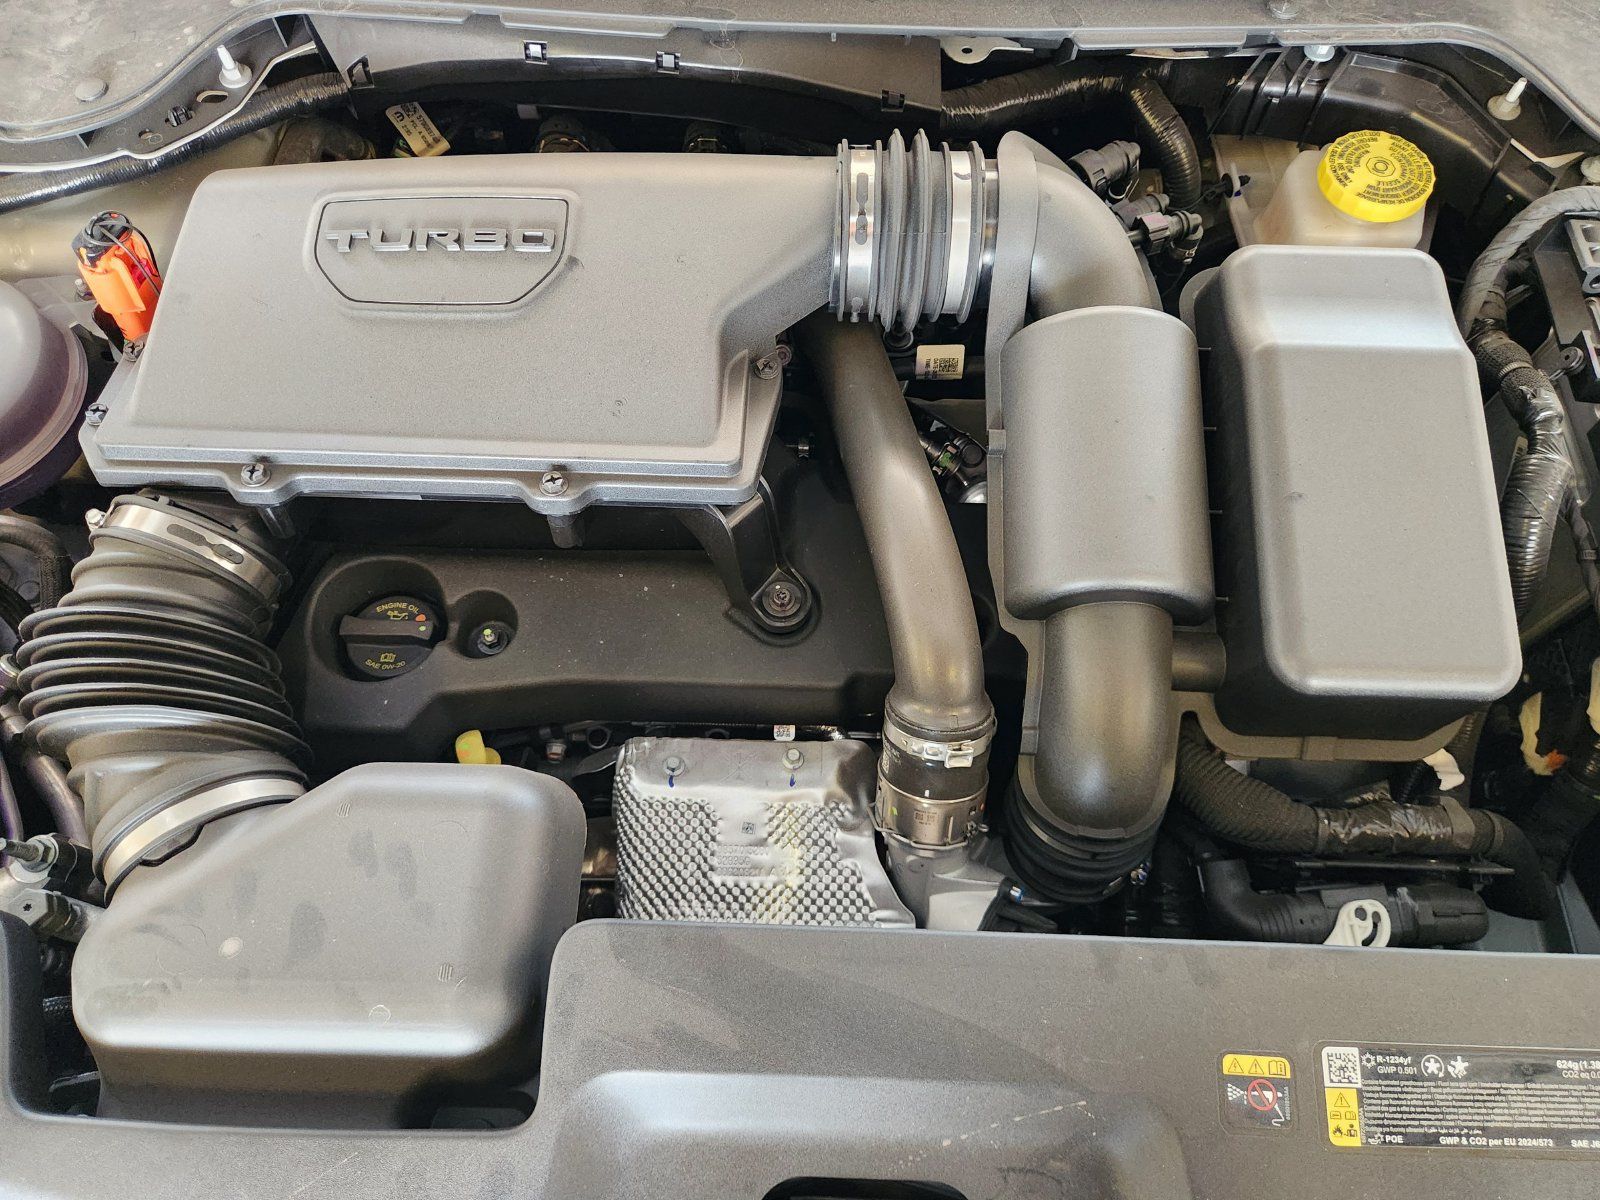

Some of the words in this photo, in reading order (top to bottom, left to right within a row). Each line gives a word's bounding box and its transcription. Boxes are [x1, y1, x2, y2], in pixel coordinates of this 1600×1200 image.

[326, 228, 556, 252] TURBO
[376, 602, 408, 613] ENGINE
[408, 604, 420, 615] OIL
[365, 659, 381, 670] SAE
[381, 660, 406, 671] 0W-20
[1376, 1055, 1412, 1065] R-1234yf
[1377, 1065, 1397, 1074] GWP
[1397, 1066, 1417, 1075] 0.501
[1562, 1070, 1579, 1078] CO2
[1385, 1135, 1404, 1144] POE
[1439, 1136, 1460, 1145] GWP
[1461, 1136, 1469, 1145] &
[1469, 1136, 1488, 1146] CO2
[1488, 1138, 1503, 1147] per
[1503, 1137, 1517, 1146] EU
[1517, 1137, 1554, 1147] 2024/573
[1571, 1139, 1590, 1148] SAE
